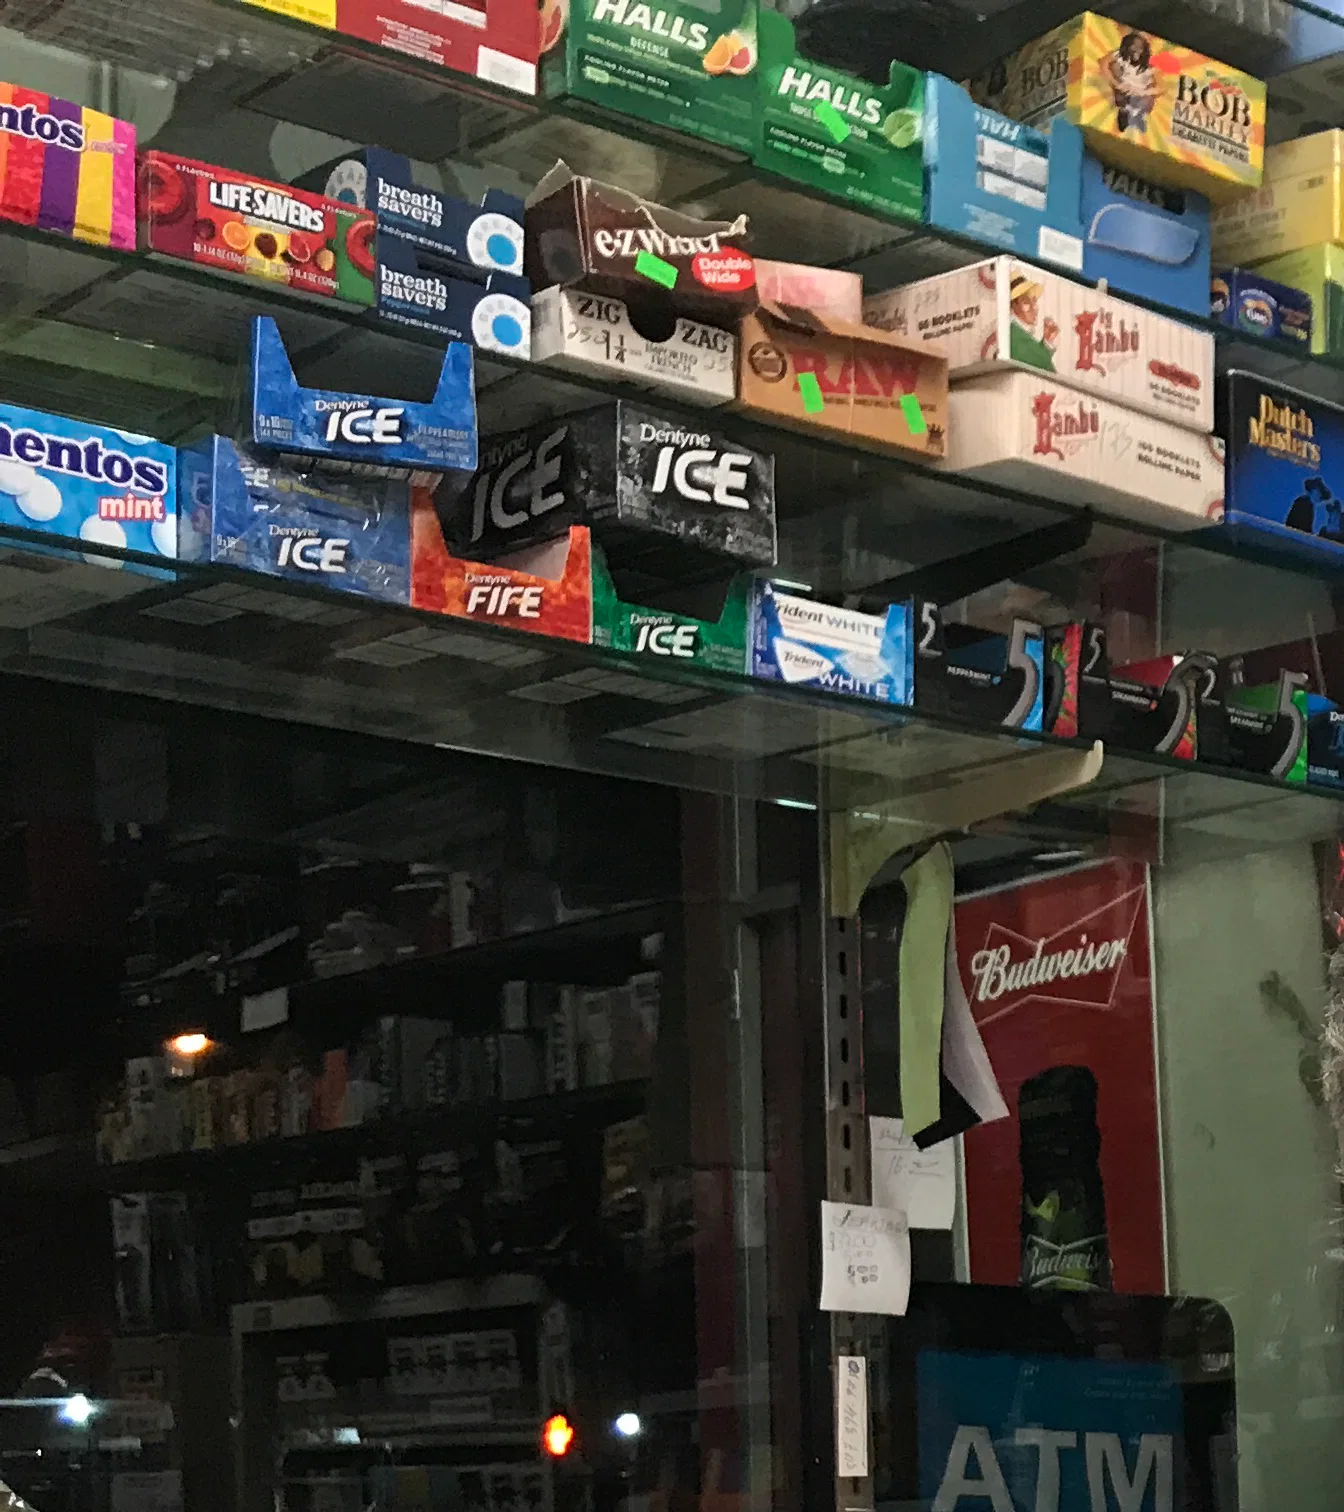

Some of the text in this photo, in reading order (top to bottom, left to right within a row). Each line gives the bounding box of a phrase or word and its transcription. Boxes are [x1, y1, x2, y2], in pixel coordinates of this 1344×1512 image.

[592, 0, 708, 51] HALLS
[779, 67, 882, 125] HALLS
[1177, 75, 1251, 127] BOB
[209, 182, 324, 233] LIFE SAVERS
[377, 177, 443, 213] breath
[380, 264, 448, 298] breath
[701, 271, 741, 285] Wide
[578, 297, 623, 324] ZIG
[315, 400, 369, 413] Dentyne
[325, 408, 405, 444] ICE
[640, 423, 711, 450] Dentyne
[652, 446, 753, 511] ICE
[101, 496, 163, 521] mint
[466, 585, 545, 619] FIRE
[818, 671, 890, 698] WHITE
[971, 931, 1129, 1002] Budweiser
